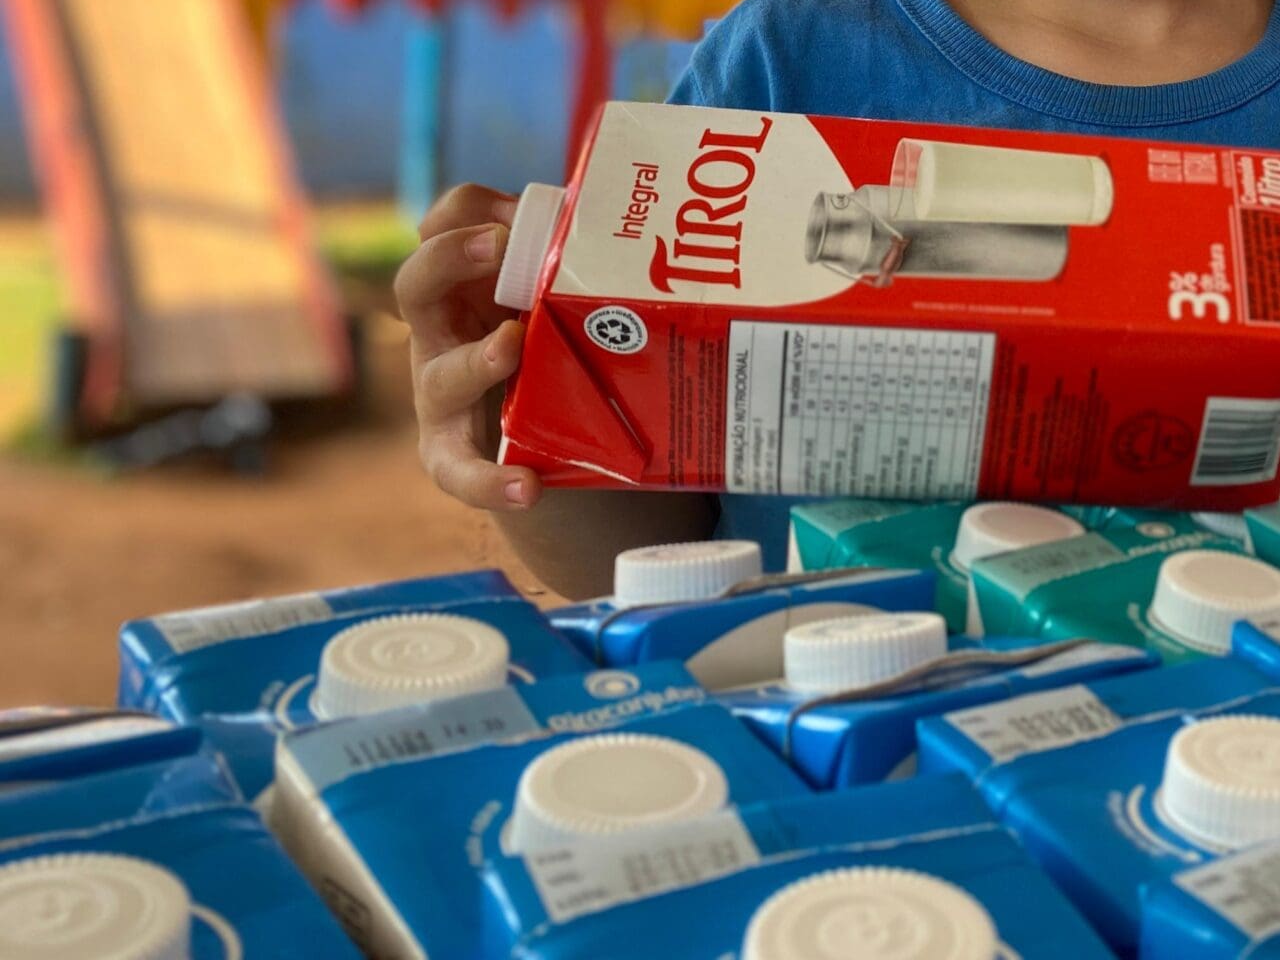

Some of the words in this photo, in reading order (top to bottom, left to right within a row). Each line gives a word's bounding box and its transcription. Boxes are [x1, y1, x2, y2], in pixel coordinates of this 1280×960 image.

[613, 162, 660, 240] Integral
[649, 115, 774, 295] TIROL
[735, 349, 749, 425] NUTRICIONAL
